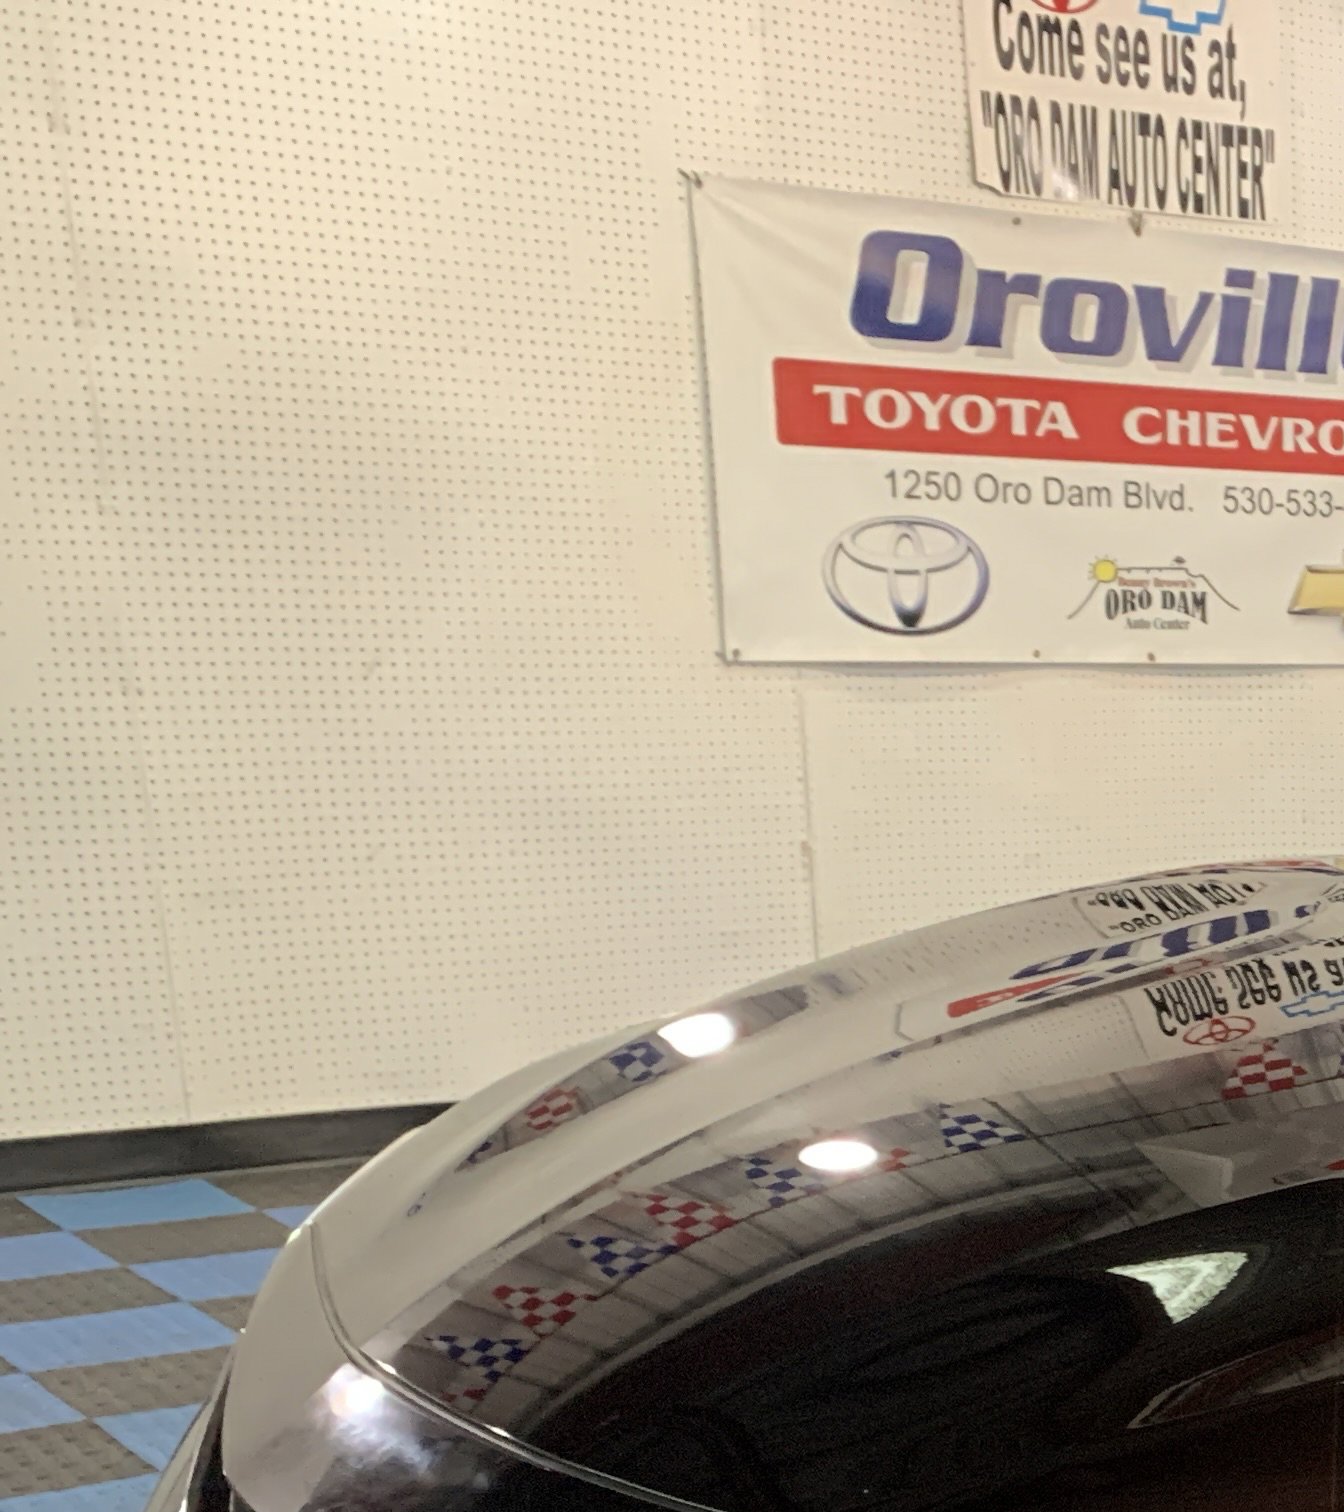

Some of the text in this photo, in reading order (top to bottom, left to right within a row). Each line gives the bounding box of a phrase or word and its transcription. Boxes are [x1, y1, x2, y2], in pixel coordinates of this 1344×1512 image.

[993, 0, 1247, 120] Come see us at,
[980, 90, 1275, 220] "ORO DAM AUTO CENTER"
[812, 384, 1079, 440] TOYOTA
[885, 467, 962, 502] 1250
[974, 472, 1032, 505] Oro
[1043, 476, 1112, 508] Dam
[1123, 480, 1194, 513] Blvd.
[1105, 588, 1209, 625] ORO DAM
